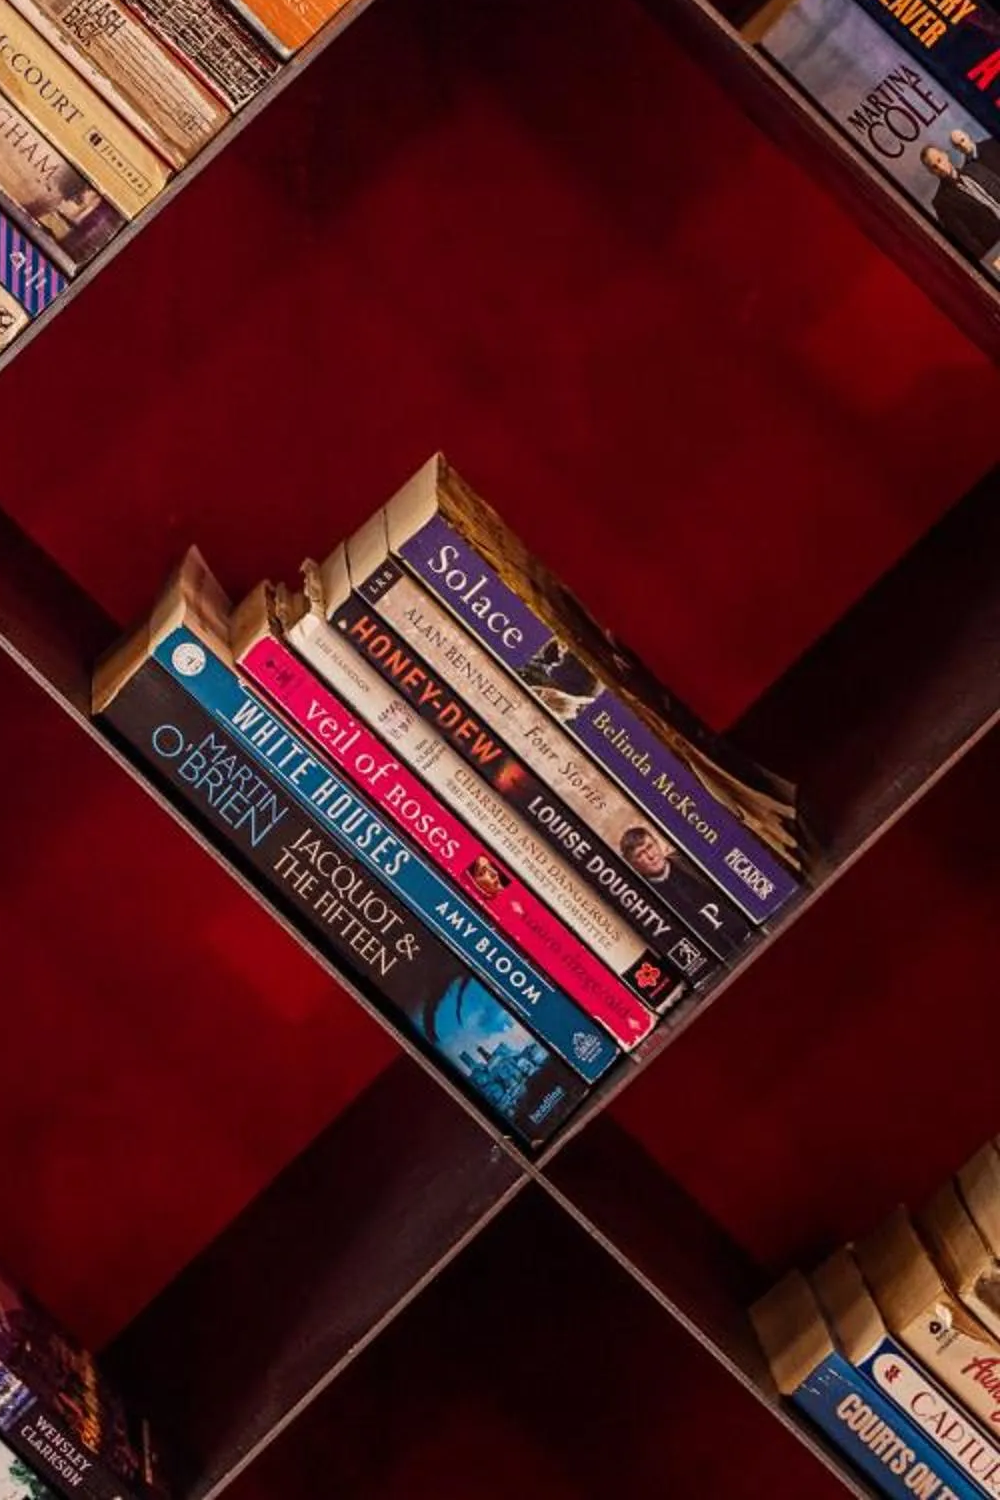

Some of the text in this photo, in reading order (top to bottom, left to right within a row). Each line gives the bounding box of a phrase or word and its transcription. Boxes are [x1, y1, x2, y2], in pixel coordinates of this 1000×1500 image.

[846, 63, 918, 134] MARTINA
[865, 76, 948, 160] COLE
[427, 544, 526, 649] Solace
[350, 616, 500, 764] HONEY-DEW
[402, 607, 515, 716] ALAN BENNETT
[149, 722, 273, 846] O'BRIEN
[197, 733, 288, 824] MARTIN
[231, 700, 314, 783] WHITE
[311, 779, 409, 876] HOUSES
[523, 726, 607, 810] Four Stories
[592, 710, 719, 844] Belinda McKeon
[272, 847, 396, 975] THE FIFTEEN
[291, 829, 421, 959] JACQUOT &
[527, 796, 670, 937] LOUISE DOUGHTY
[723, 847, 776, 898] PICADOR
[435, 900, 541, 1004] AMY BLOOM
[20, 1424, 82, 1486] CLARKSON
[32, 1417, 91, 1474] WENSLEY
[833, 1391, 943, 1500] COURTS ON
